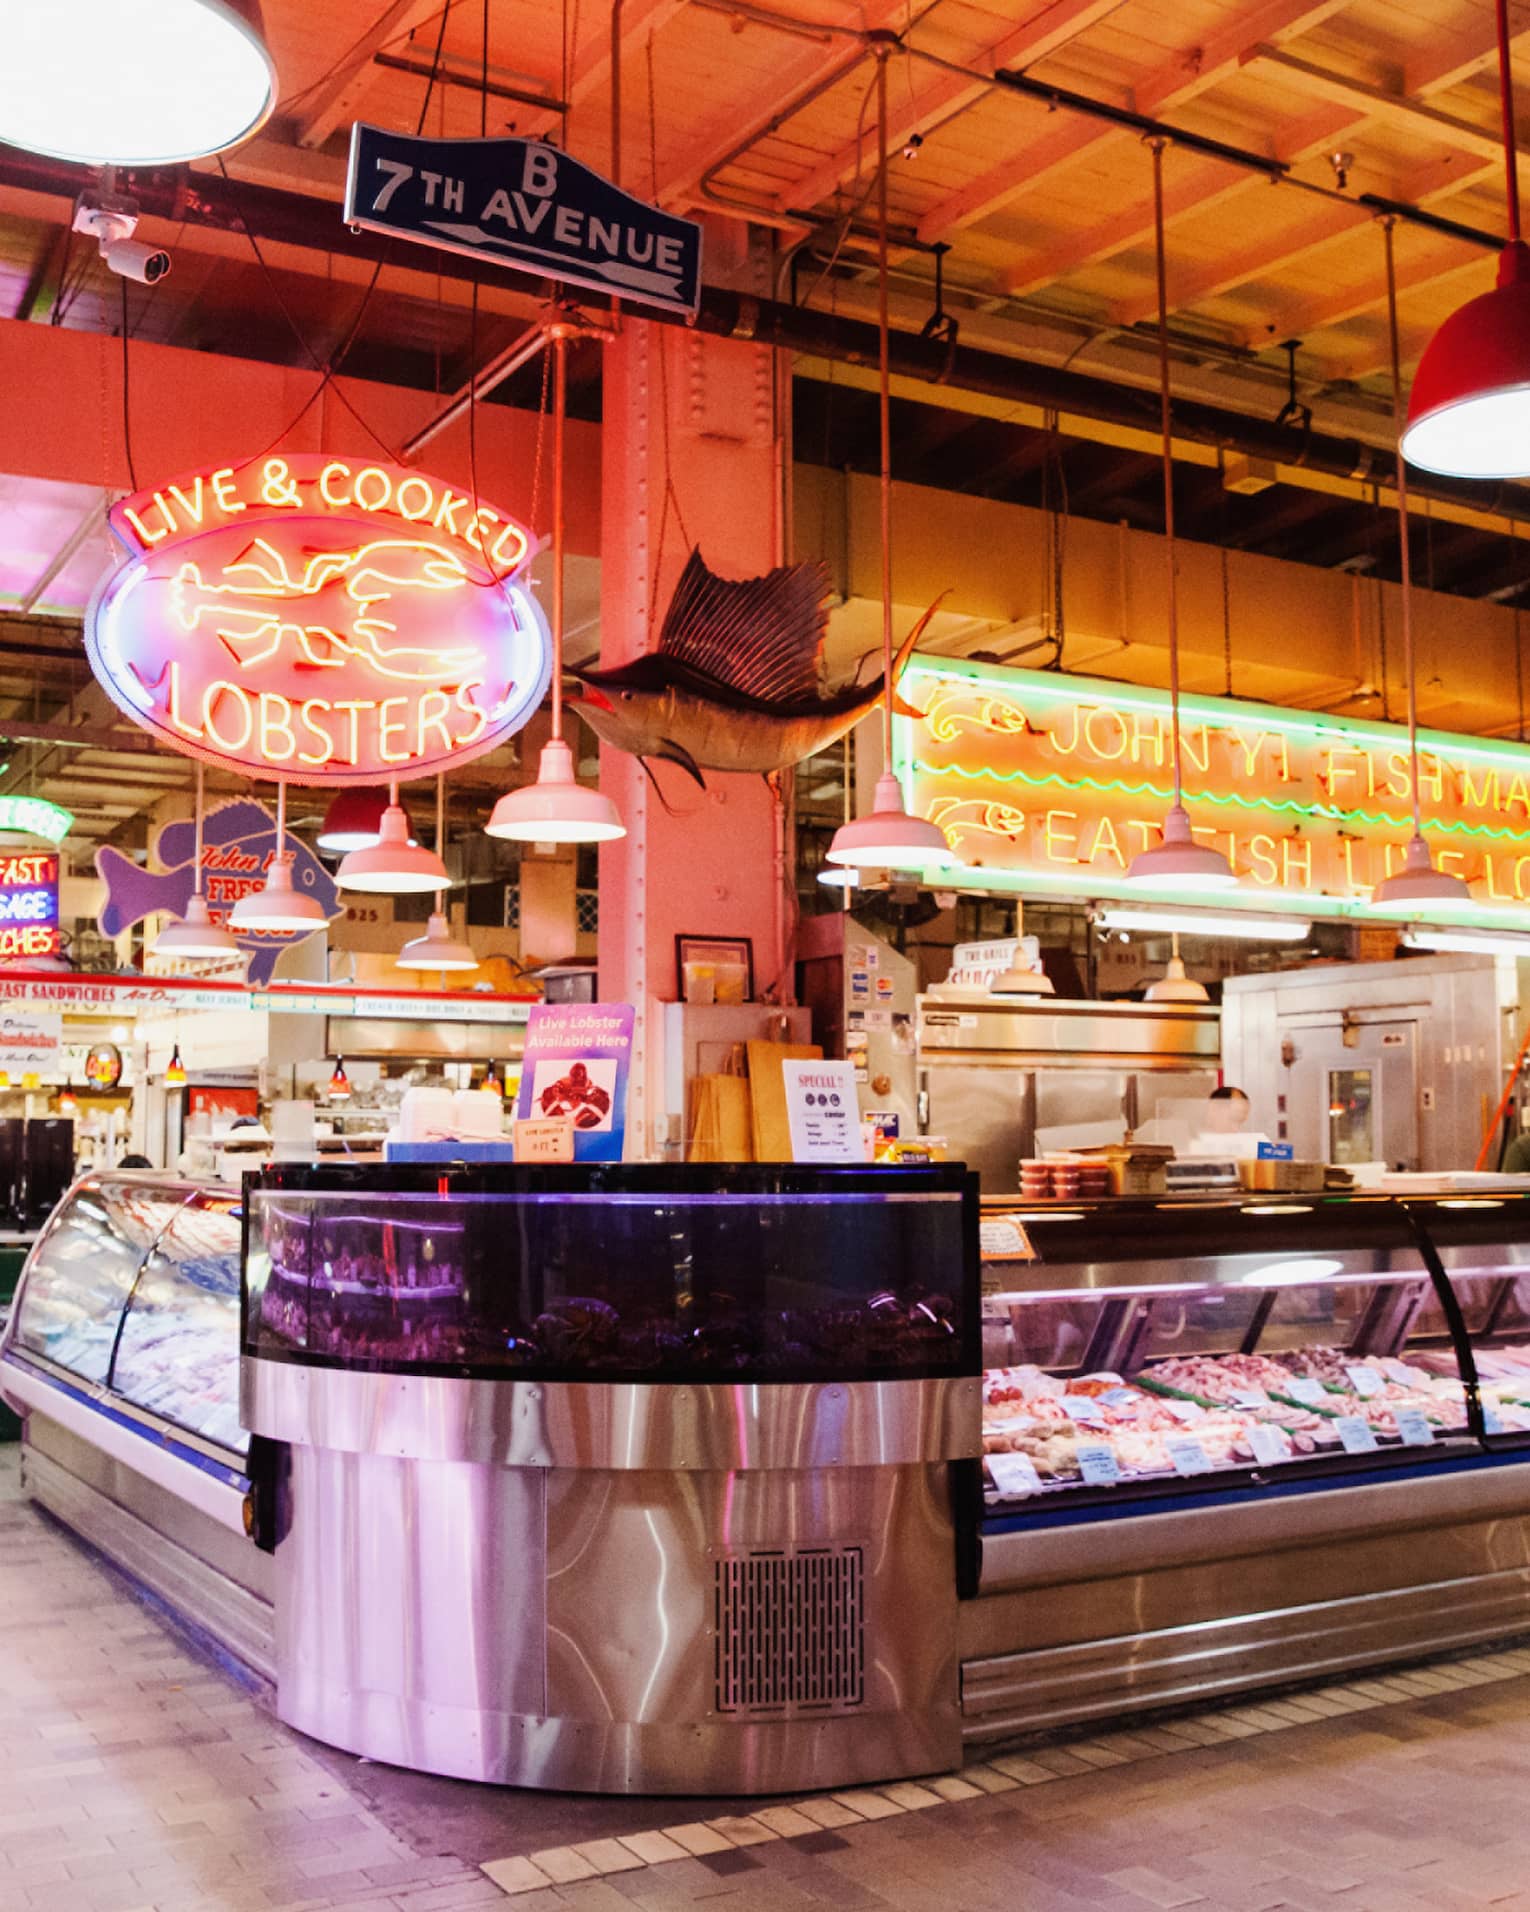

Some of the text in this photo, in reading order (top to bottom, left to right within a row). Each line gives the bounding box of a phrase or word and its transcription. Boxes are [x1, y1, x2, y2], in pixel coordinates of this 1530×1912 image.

[521, 144, 558, 198] B
[480, 188, 685, 275] AVENUE
[125, 458, 528, 567] LIVE & COOKED
[170, 661, 488, 766] LOBSTERS
[1049, 703, 1209, 772] JOHN
[1235, 727, 1289, 782] YI
[1327, 747, 1443, 803] FISH
[201, 845, 260, 871] John
[1046, 810, 1162, 869] EAT
[1191, 826, 1314, 889] ISH
[1344, 839, 1465, 892] LIE
[207, 877, 267, 902] FRES
[31, 984, 116, 1001] SANDWICHES
[528, 1035, 629, 1048] Available Here
[539, 1015, 624, 1030] Live Lobster
